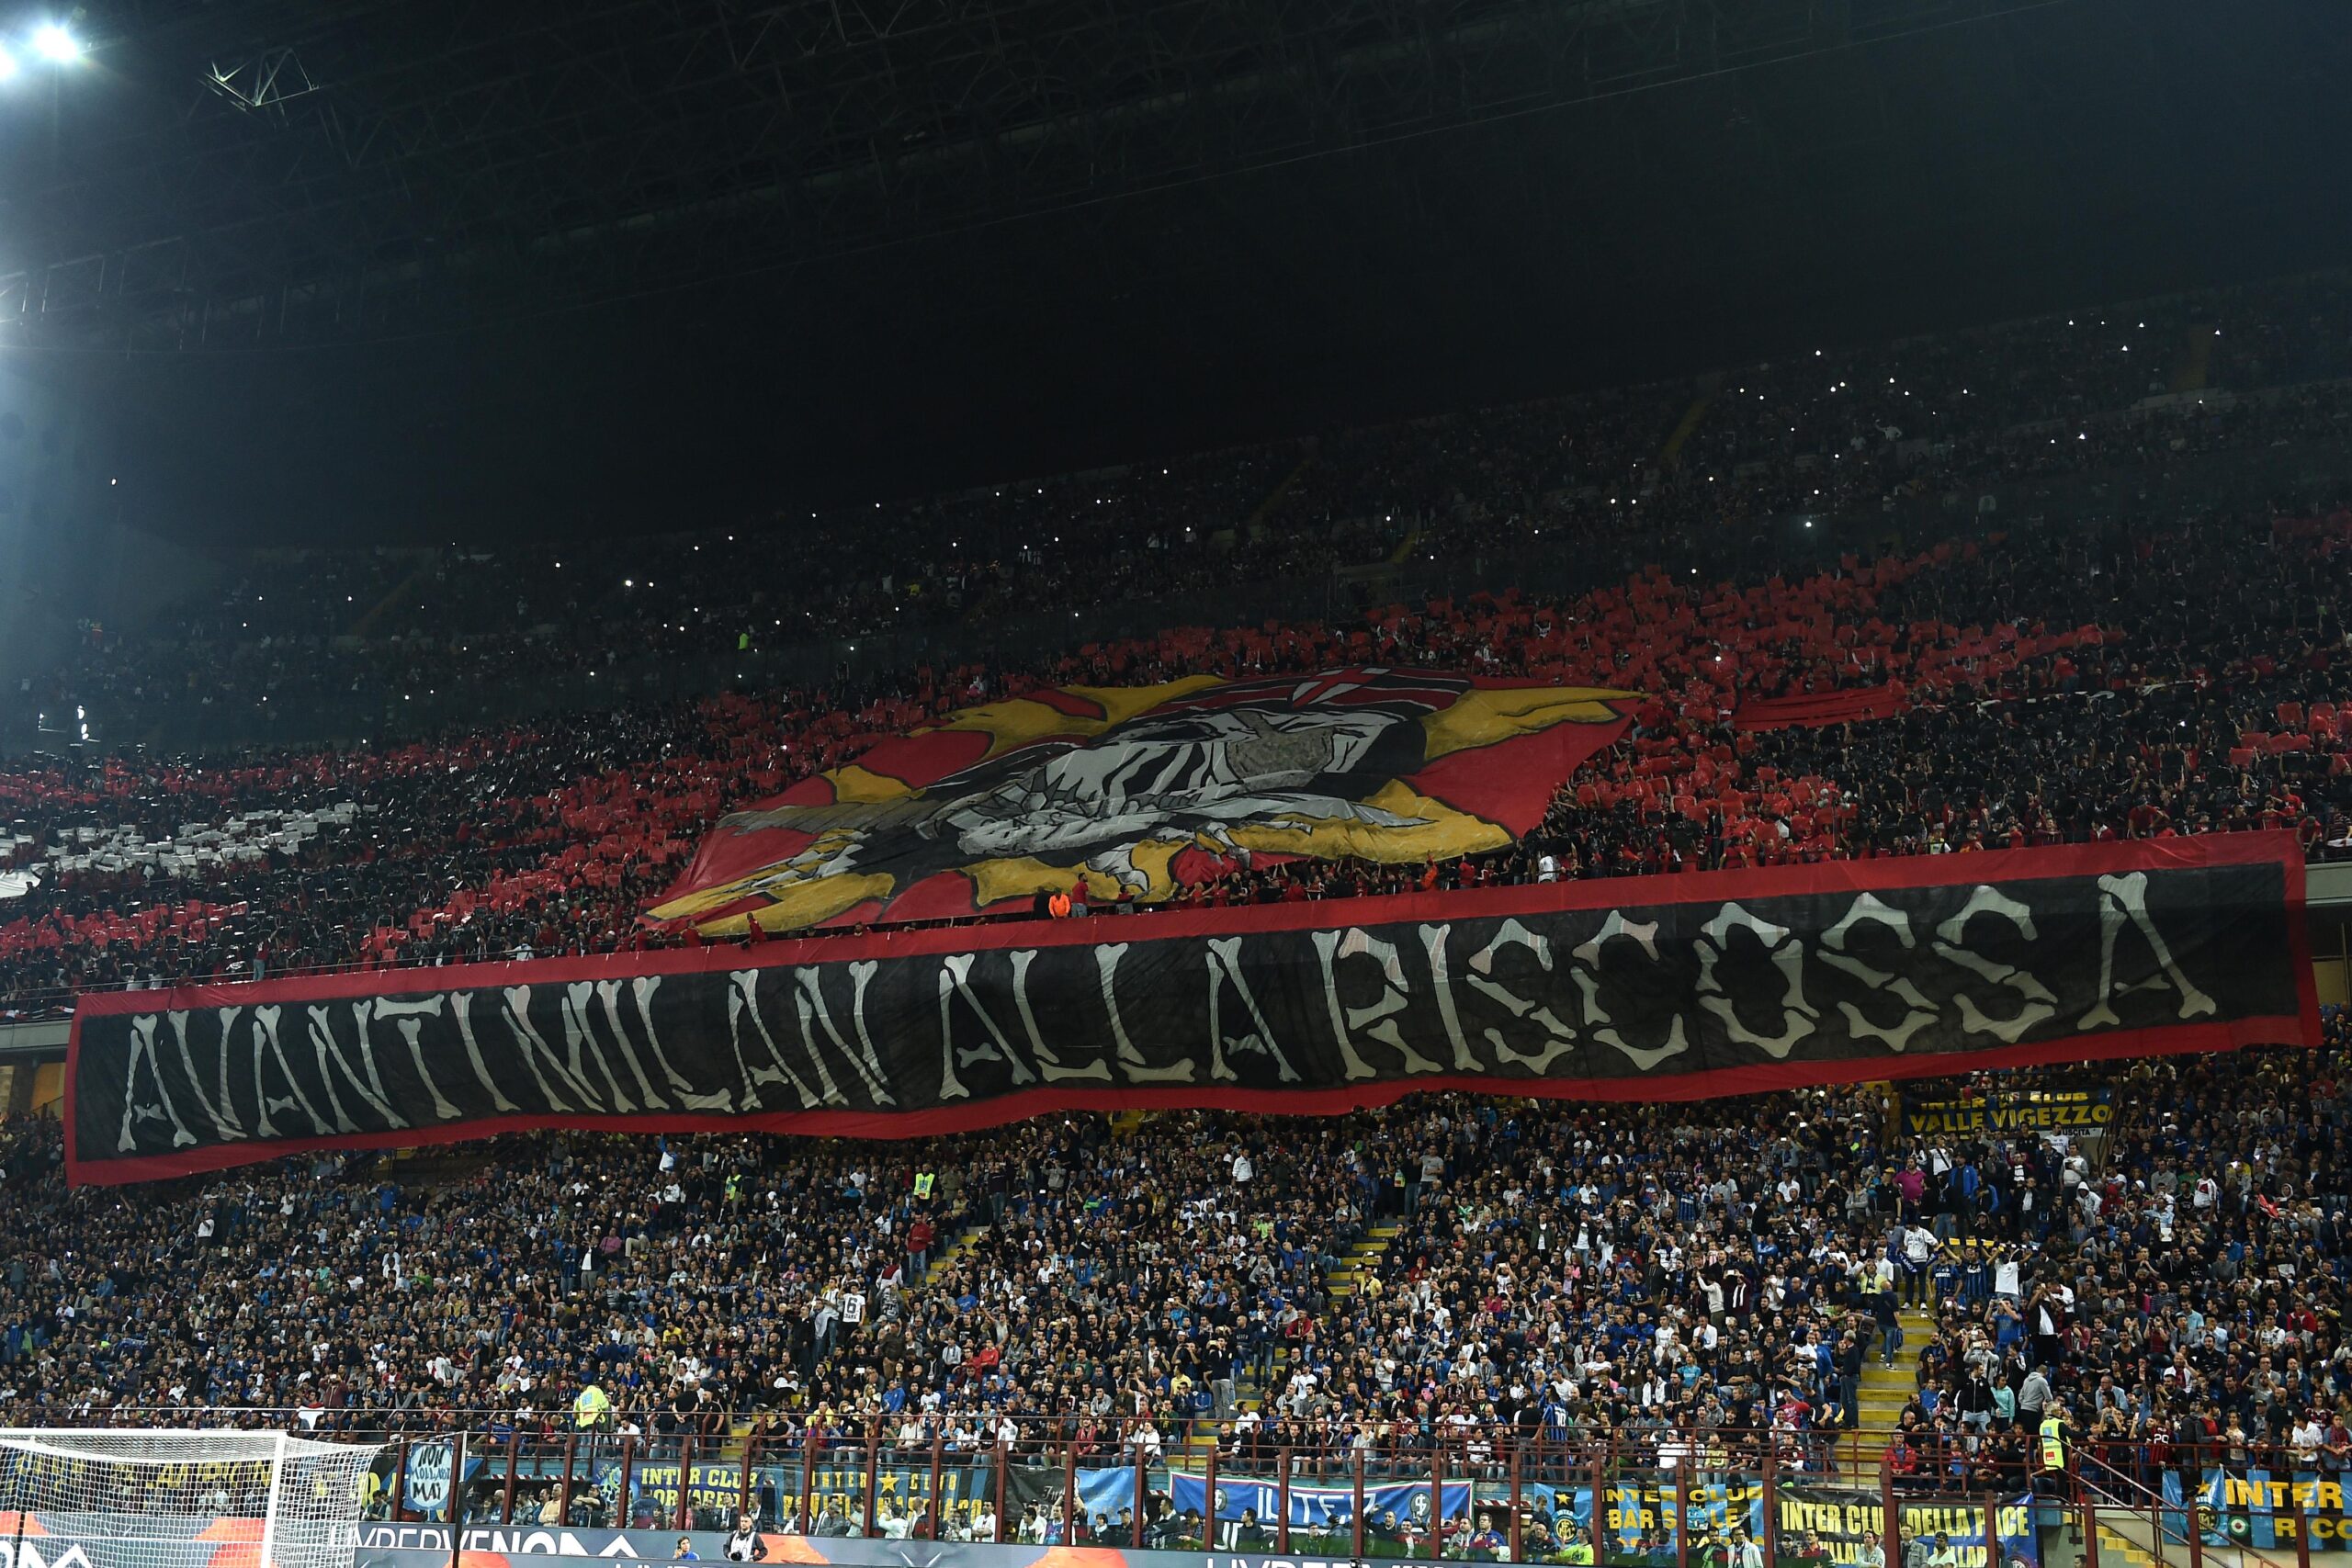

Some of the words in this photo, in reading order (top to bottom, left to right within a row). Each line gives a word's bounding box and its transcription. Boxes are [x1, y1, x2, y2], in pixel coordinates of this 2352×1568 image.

[118, 991, 521, 1152] AVANTI
[502, 960, 899, 1113] MILAN
[938, 937, 1303, 1100] ALLA
[1312, 871, 2217, 1081] RISCOSSA
[1909, 1111, 1984, 1134] VALLE
[1990, 1104, 2112, 1130] VIGEZZO
[2063, 1128, 2091, 1136] USCITA
[847, 1297, 858, 1314] 6
[1555, 1412, 1567, 1427] 10
[418, 1446, 447, 1468] NON
[640, 1467, 701, 1485] INTR
[811, 1470, 867, 1489] INTER
[1689, 1487, 1763, 1503] CLUB
[2224, 1478, 2344, 1509] INTER
[1608, 1509, 1655, 1529] BAR
[1781, 1501, 1842, 1533] INTER
[1846, 1504, 1885, 1536] CLU
[1905, 1507, 1972, 1537] DELLA
